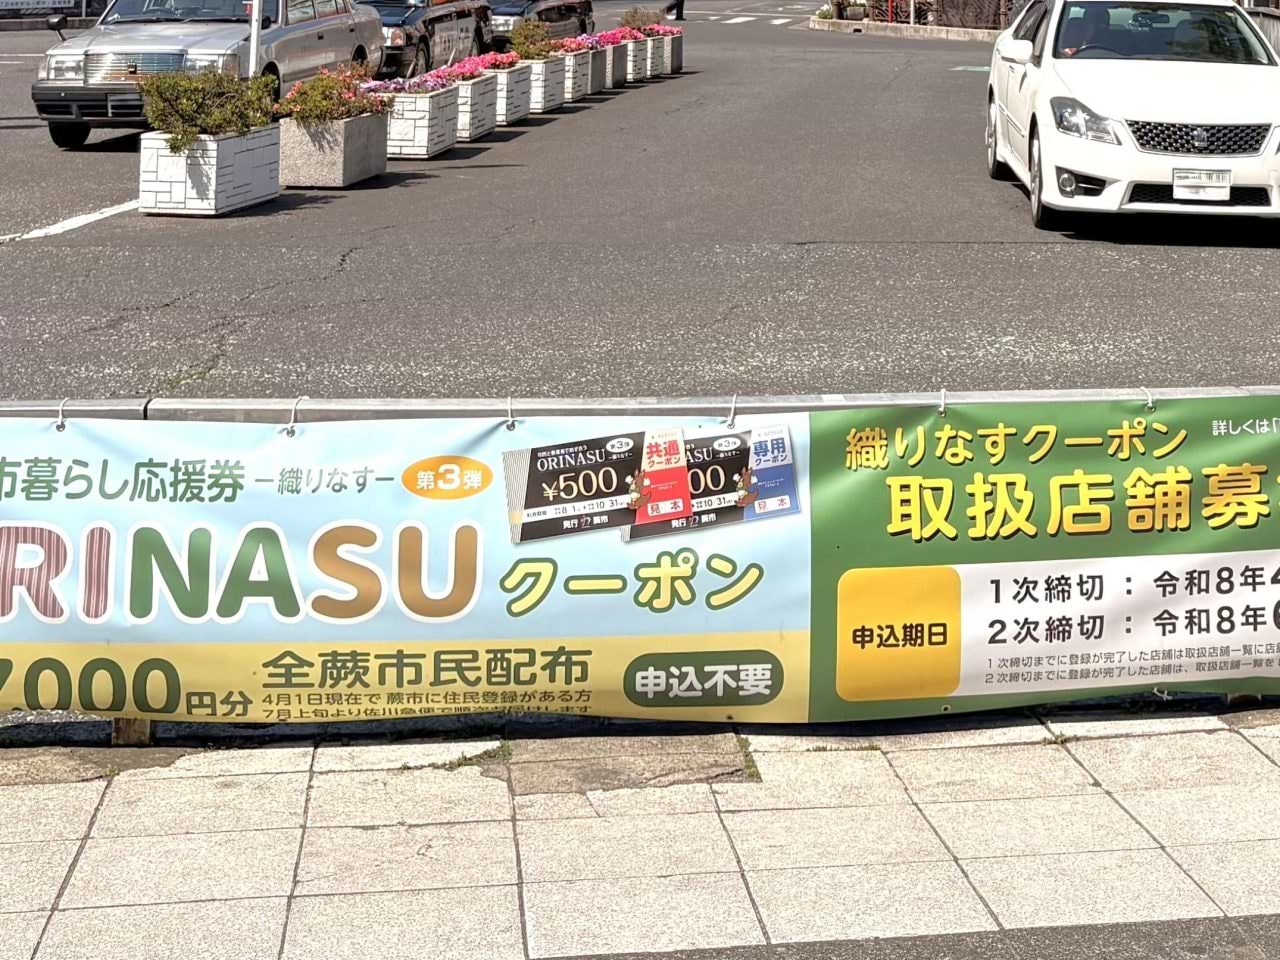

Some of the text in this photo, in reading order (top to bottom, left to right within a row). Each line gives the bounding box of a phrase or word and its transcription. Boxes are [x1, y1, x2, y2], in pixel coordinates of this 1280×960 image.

[646, 438, 681, 461] 共通
[753, 437, 787, 458] 専用
[845, 417, 1188, 470] 織りなすクーポン
[536, 448, 606, 472] ORINASU
[647, 456, 682, 469] クーポン
[754, 453, 788, 467] クーポン
[415, 464, 484, 492] 第3弾
[541, 466, 618, 502] ¥500
[0, 524, 478, 619] RINASU
[500, 547, 765, 618] クーポン
[852, 622, 948, 650] 申込期日
[262, 646, 593, 689] 全蕨市民配布
[635, 663, 773, 698] 申込不要
